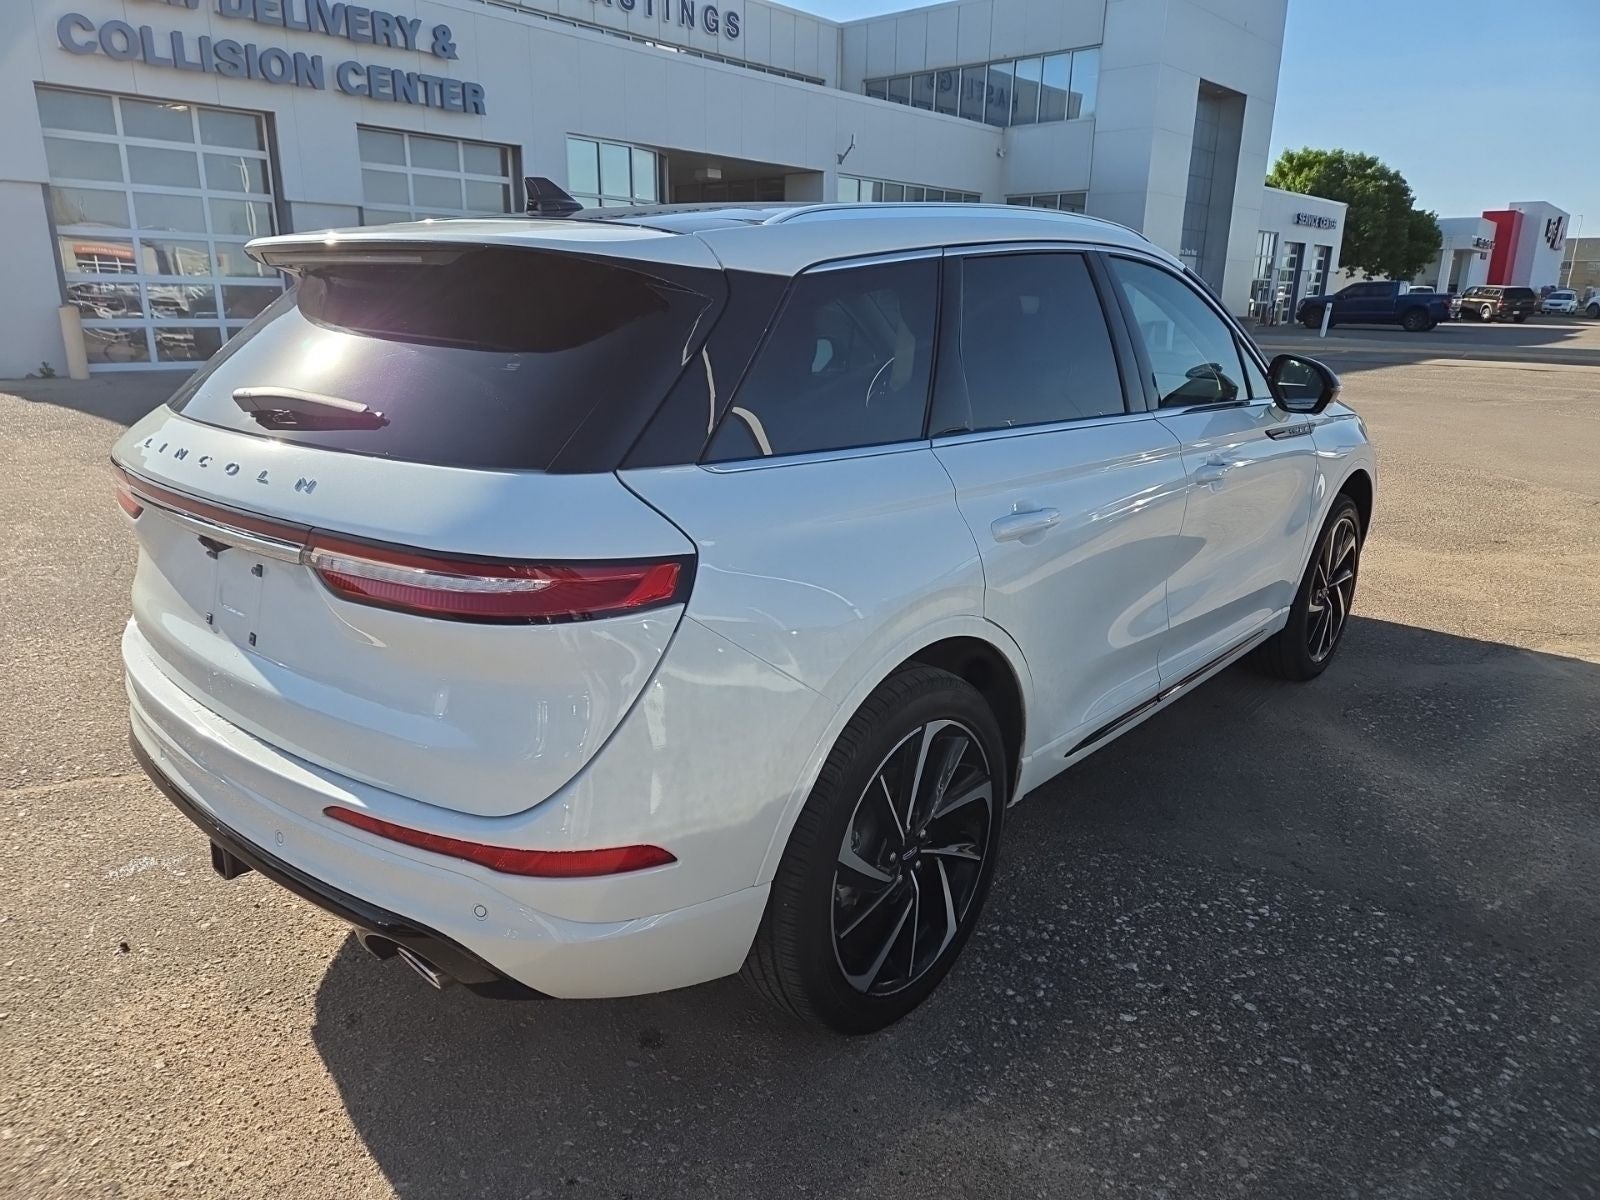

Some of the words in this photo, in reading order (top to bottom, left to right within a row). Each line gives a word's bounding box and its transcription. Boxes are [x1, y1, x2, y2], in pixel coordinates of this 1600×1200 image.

[57, 12, 325, 90] COLLISION
[336, 60, 486, 115] CENTER
[432, 24, 458, 60] &
[144, 438, 318, 494] LINCOLN
